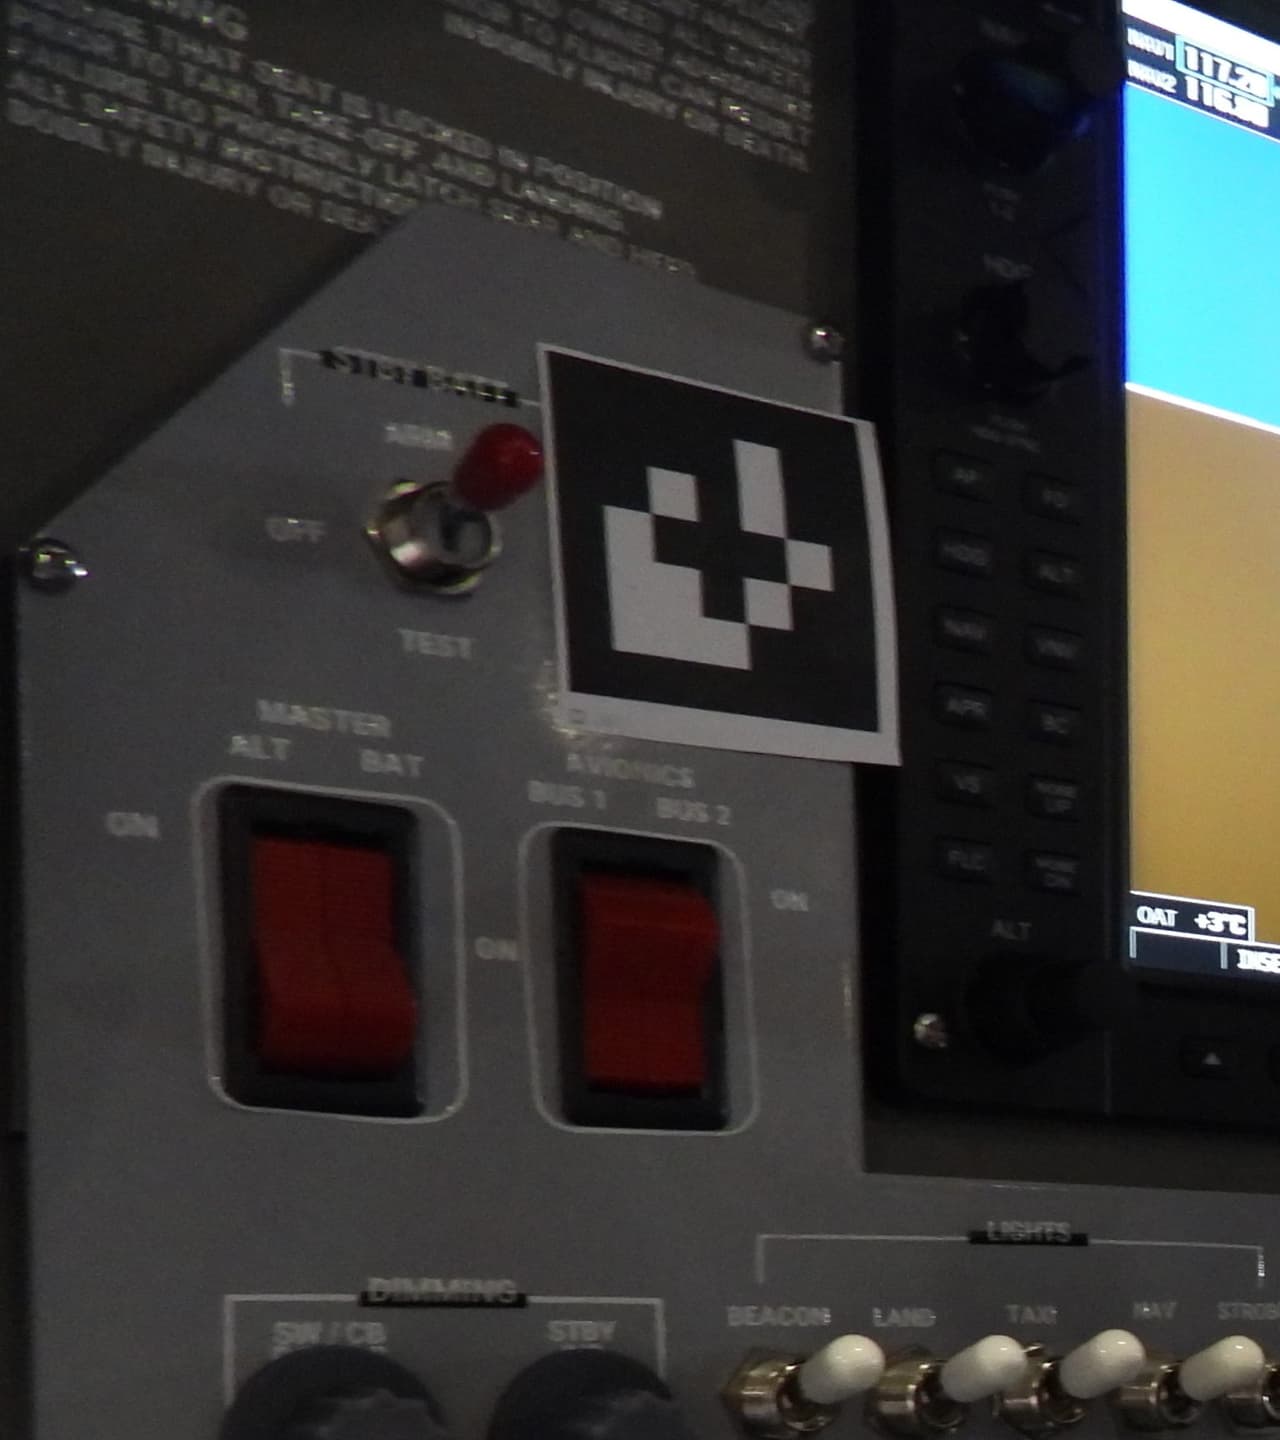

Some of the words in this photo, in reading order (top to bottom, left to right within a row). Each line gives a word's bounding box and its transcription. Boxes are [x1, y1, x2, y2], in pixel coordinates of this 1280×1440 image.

[257, 699, 391, 738] MASTER
[229, 735, 291, 763] ALT
[360, 750, 425, 780] BAT
[566, 753, 695, 789] AVIONICS
[105, 812, 160, 839] ON
[714, 804, 732, 826] 2
[770, 888, 810, 913] ON
[1136, 905, 1178, 928] OAT
[727, 1305, 832, 1327] BEACON
[872, 1306, 937, 1329] LAND
